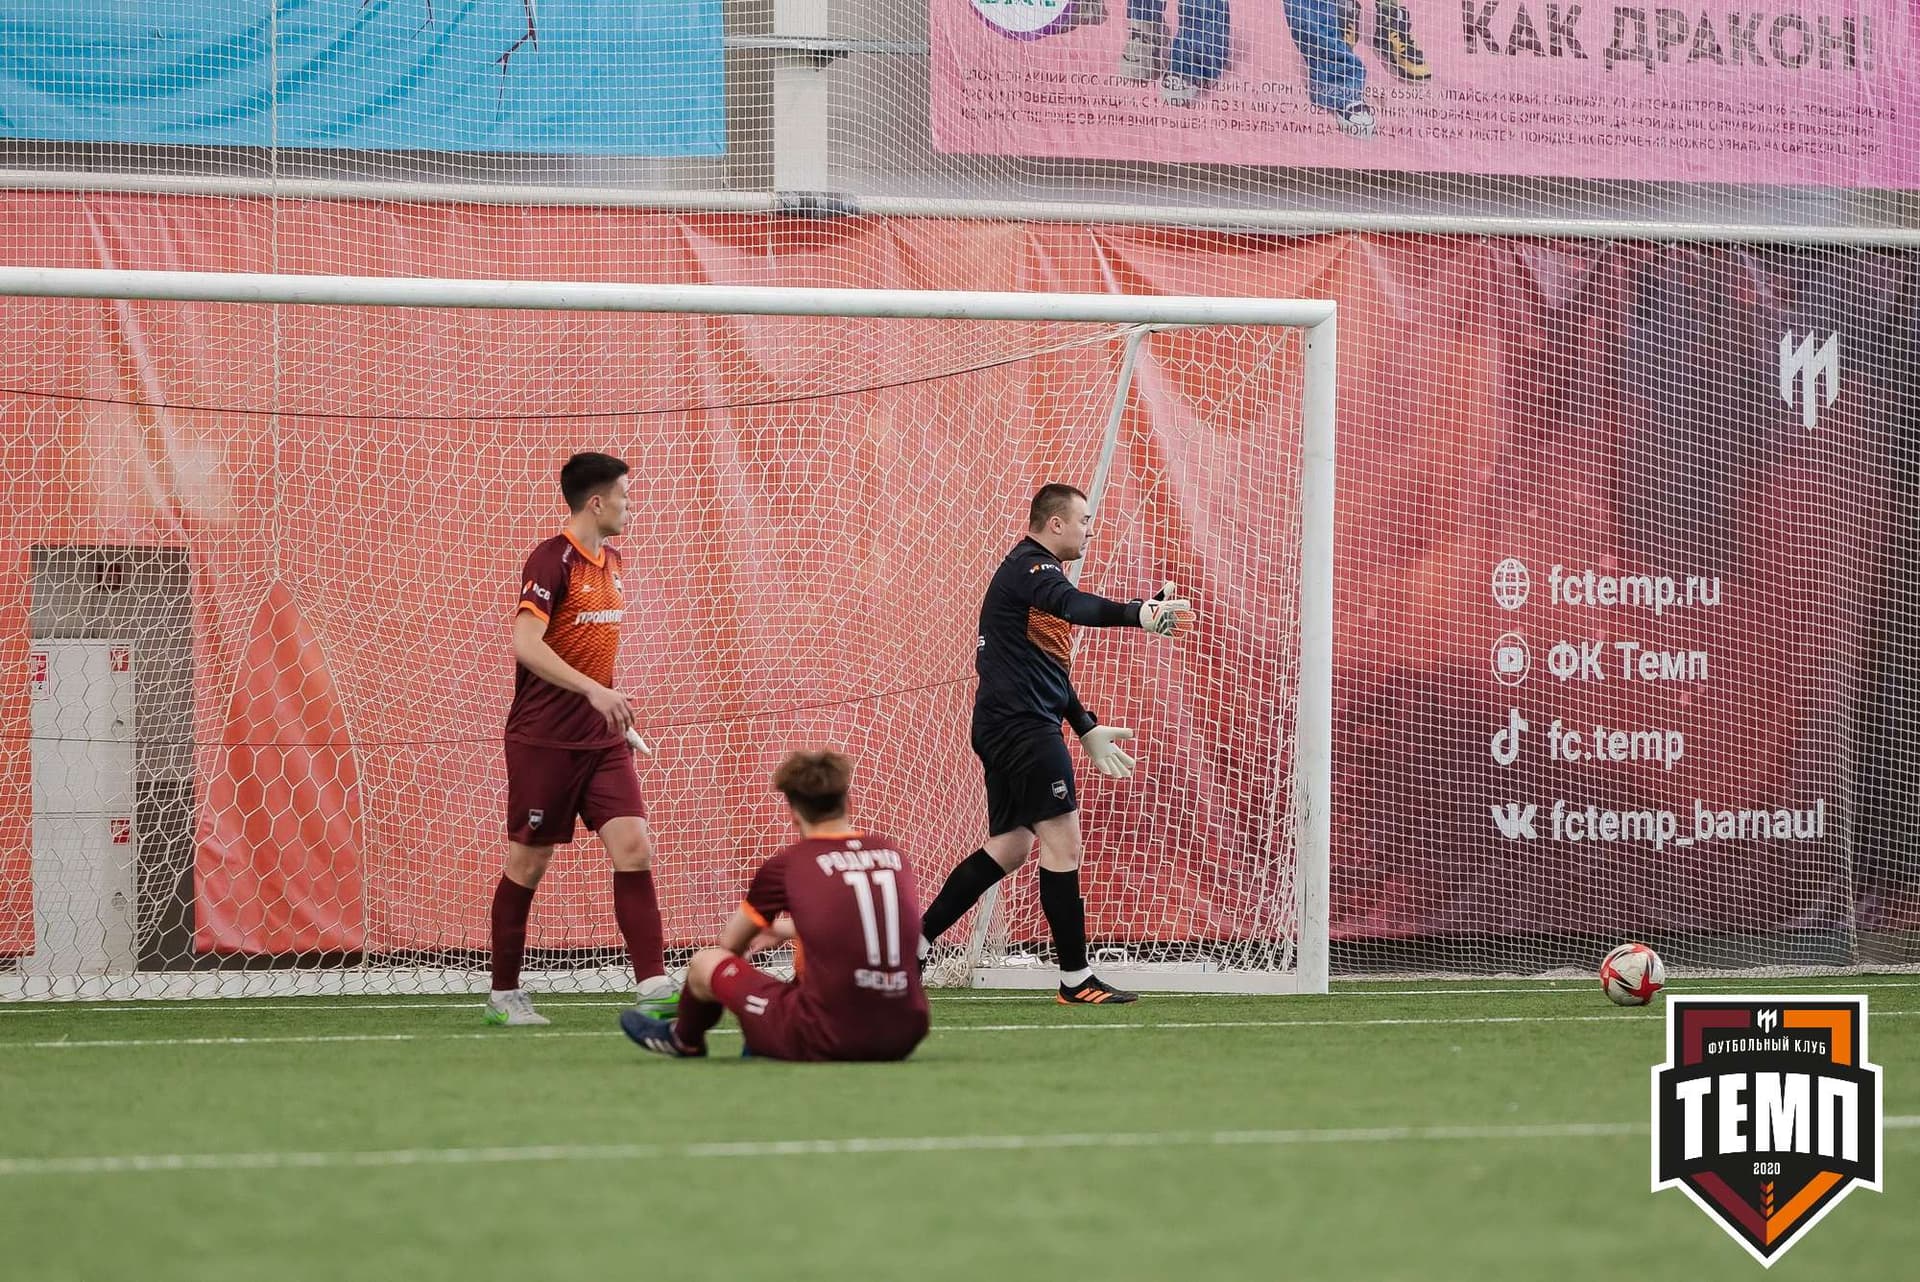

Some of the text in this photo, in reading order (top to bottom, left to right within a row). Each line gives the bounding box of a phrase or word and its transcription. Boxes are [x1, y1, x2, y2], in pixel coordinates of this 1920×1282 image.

[1461, 0, 1874, 74] КАК ДРАКОН!
[1071, 74, 1099, 86] ООО
[1262, 82, 1294, 95] ОГРН
[1211, 99, 1230, 111] ПО
[1549, 564, 1720, 615] fctemp.ru
[1548, 640, 1708, 681] ФК Темп
[1549, 720, 1684, 770] fc.temp
[1550, 799, 1824, 850] fctemp_barnaul
[843, 870, 901, 967] 11
